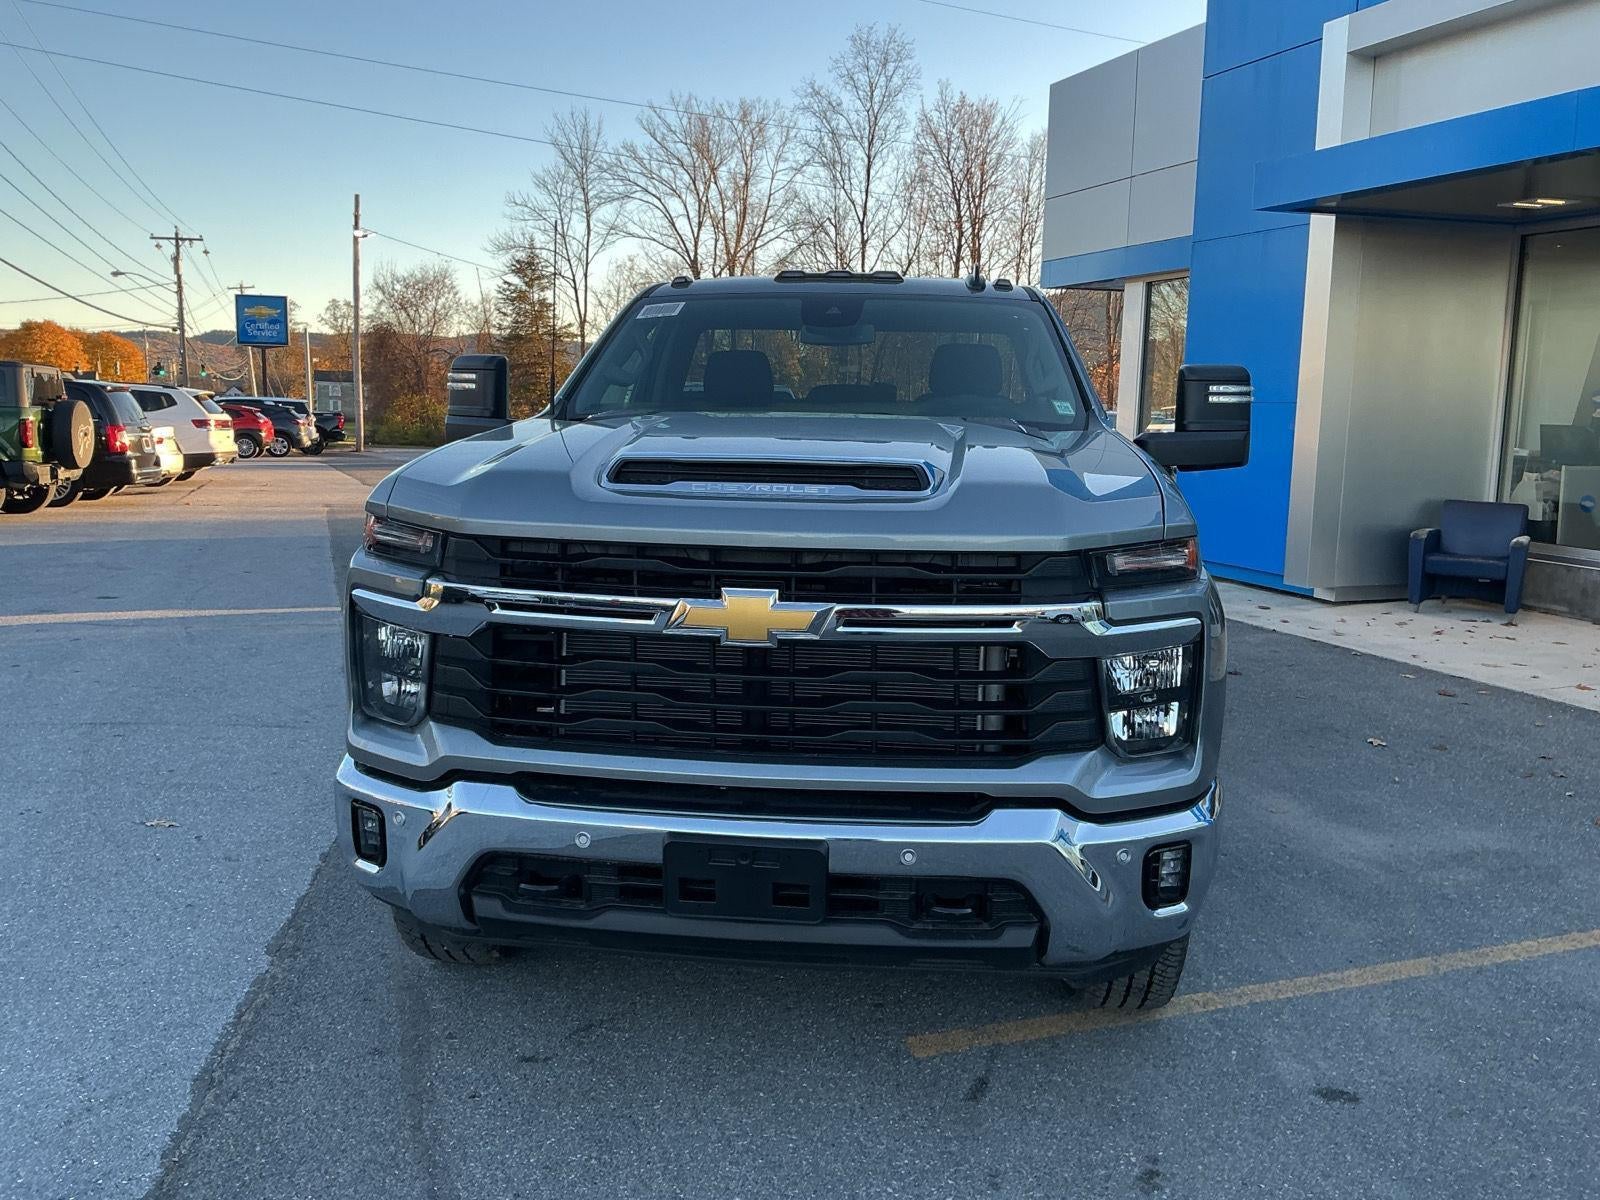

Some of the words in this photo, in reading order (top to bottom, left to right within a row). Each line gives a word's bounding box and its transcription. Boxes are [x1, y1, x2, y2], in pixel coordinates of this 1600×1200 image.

[244, 321, 280, 330] Certified
[247, 329, 278, 337] Service
[691, 482, 835, 494] CHEVROLET
